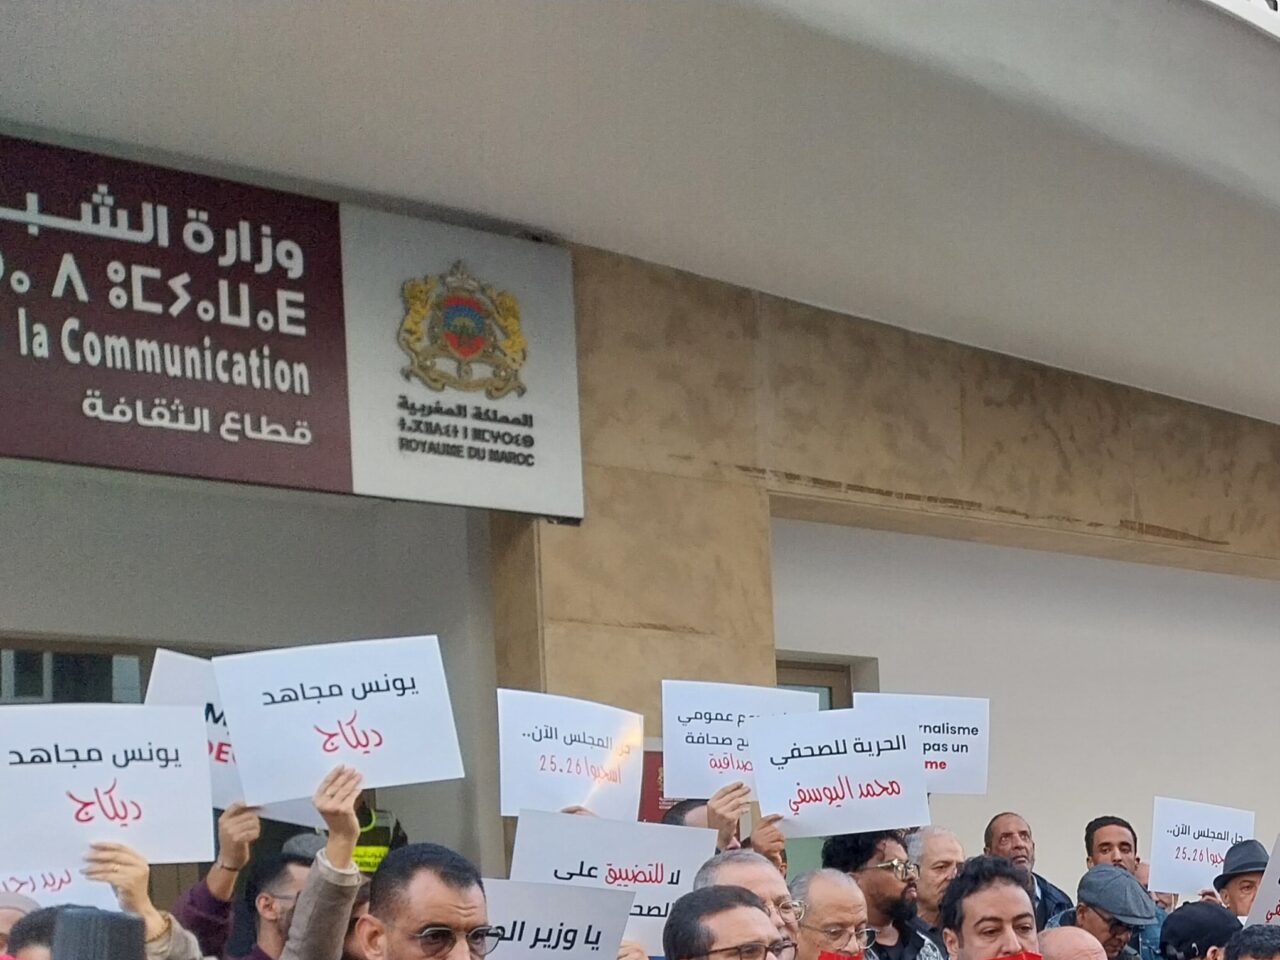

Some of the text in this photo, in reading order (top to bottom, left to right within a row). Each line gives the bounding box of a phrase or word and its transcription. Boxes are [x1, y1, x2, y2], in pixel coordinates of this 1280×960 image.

[182, 208, 304, 279] وزارة
[18, 307, 310, 396] la Communication
[82, 389, 312, 445] قطاع الثقافة
[397, 394, 534, 428] المملكة المغربية
[398, 437, 535, 467] ROYAUME DU MAROC
[262, 673, 419, 705] يونس مجاهد
[313, 709, 384, 754] ديكاج
[678, 711, 733, 727] عمومي
[919, 722, 979, 736] rnalisme
[563, 731, 612, 750] المجلس
[685, 731, 733, 746] صحافة
[853, 734, 907, 757] الحرية
[923, 742, 968, 755] pas un
[9, 743, 103, 768] مجاهد
[112, 742, 182, 768] يونس
[539, 754, 582, 775] 25.26
[709, 752, 754, 774] صداقية
[770, 739, 847, 770] للصحفي
[924, 760, 947, 770] me
[65, 777, 142, 826] ديكاج
[788, 775, 901, 815] محمد اليوسفي
[1193, 828, 1229, 841] المجلس
[1175, 846, 1225, 867] حبوا 25.26
[554, 860, 681, 887] لا للتضييق على
[529, 922, 578, 950] وزير
[584, 924, 602, 951] يا
